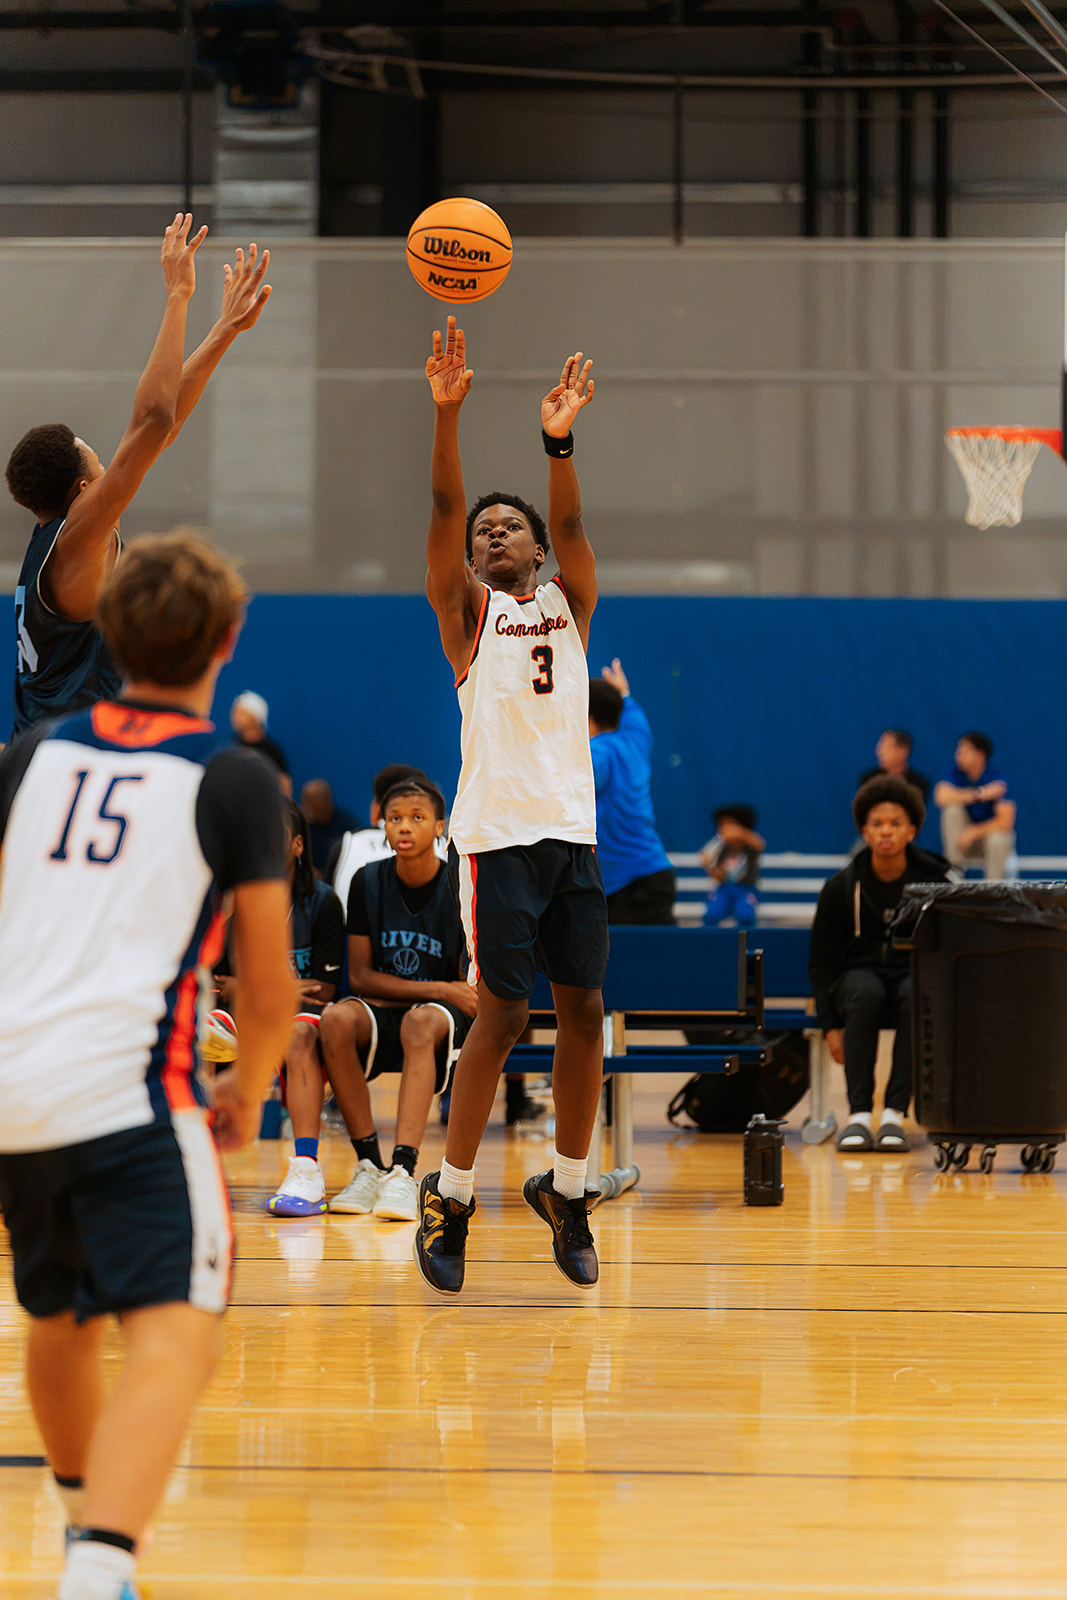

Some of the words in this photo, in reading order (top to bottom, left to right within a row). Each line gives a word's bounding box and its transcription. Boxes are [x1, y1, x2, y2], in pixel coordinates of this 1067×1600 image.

[424, 236, 491, 263] Wilson
[427, 271, 478, 290] NCAA
[531, 644, 555, 695] 3
[49, 769, 145, 864] 15
